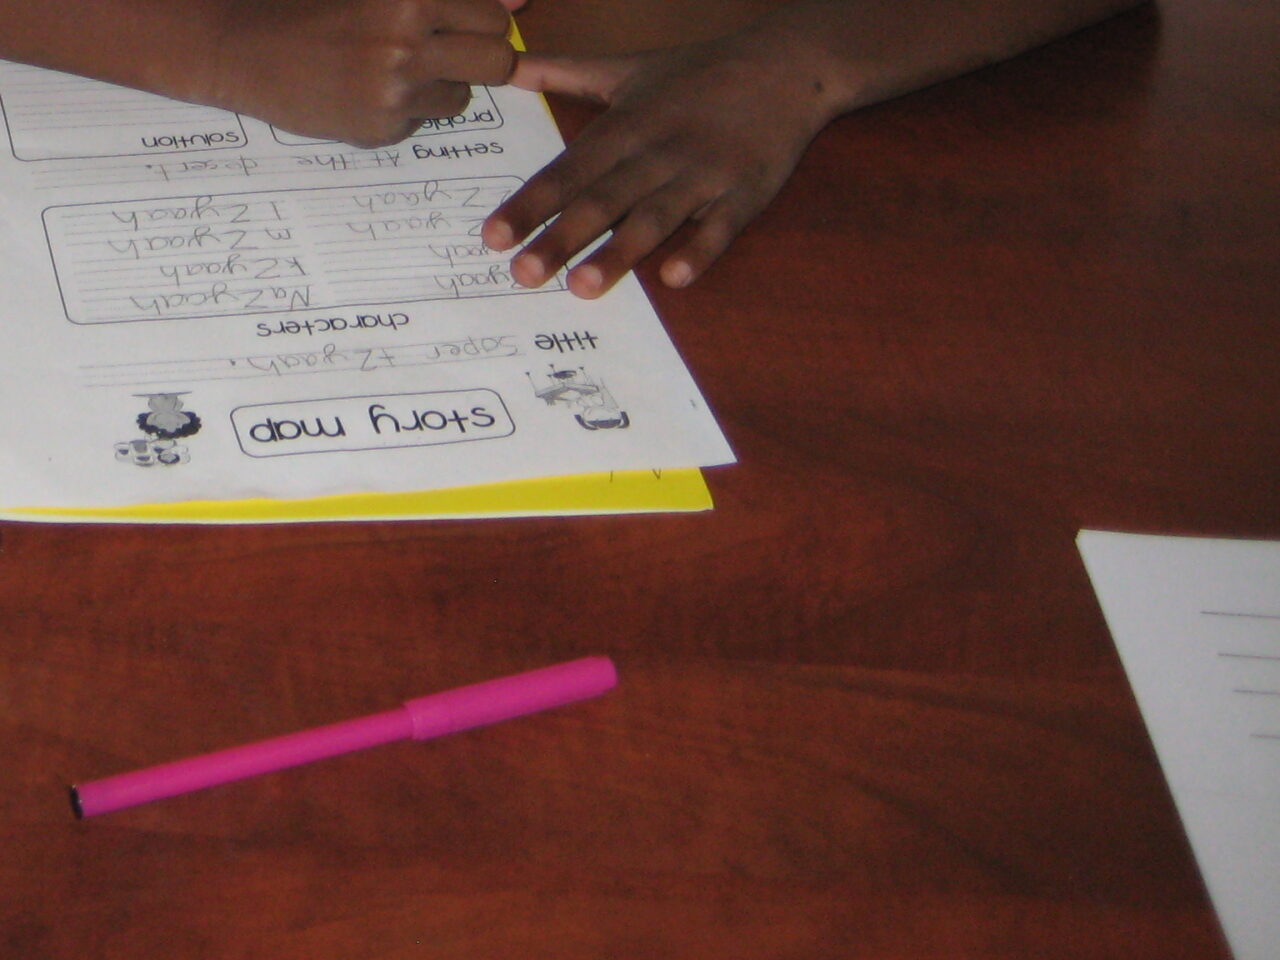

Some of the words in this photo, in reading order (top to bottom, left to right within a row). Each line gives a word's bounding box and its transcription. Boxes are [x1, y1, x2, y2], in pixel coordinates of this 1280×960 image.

[420, 109, 495, 131] proble
[141, 130, 240, 149] solution
[411, 142, 504, 160] setting
[255, 312, 410, 338] characters
[534, 330, 599, 354] title
[249, 413, 346, 444] map
[368, 404, 496, 435] story
